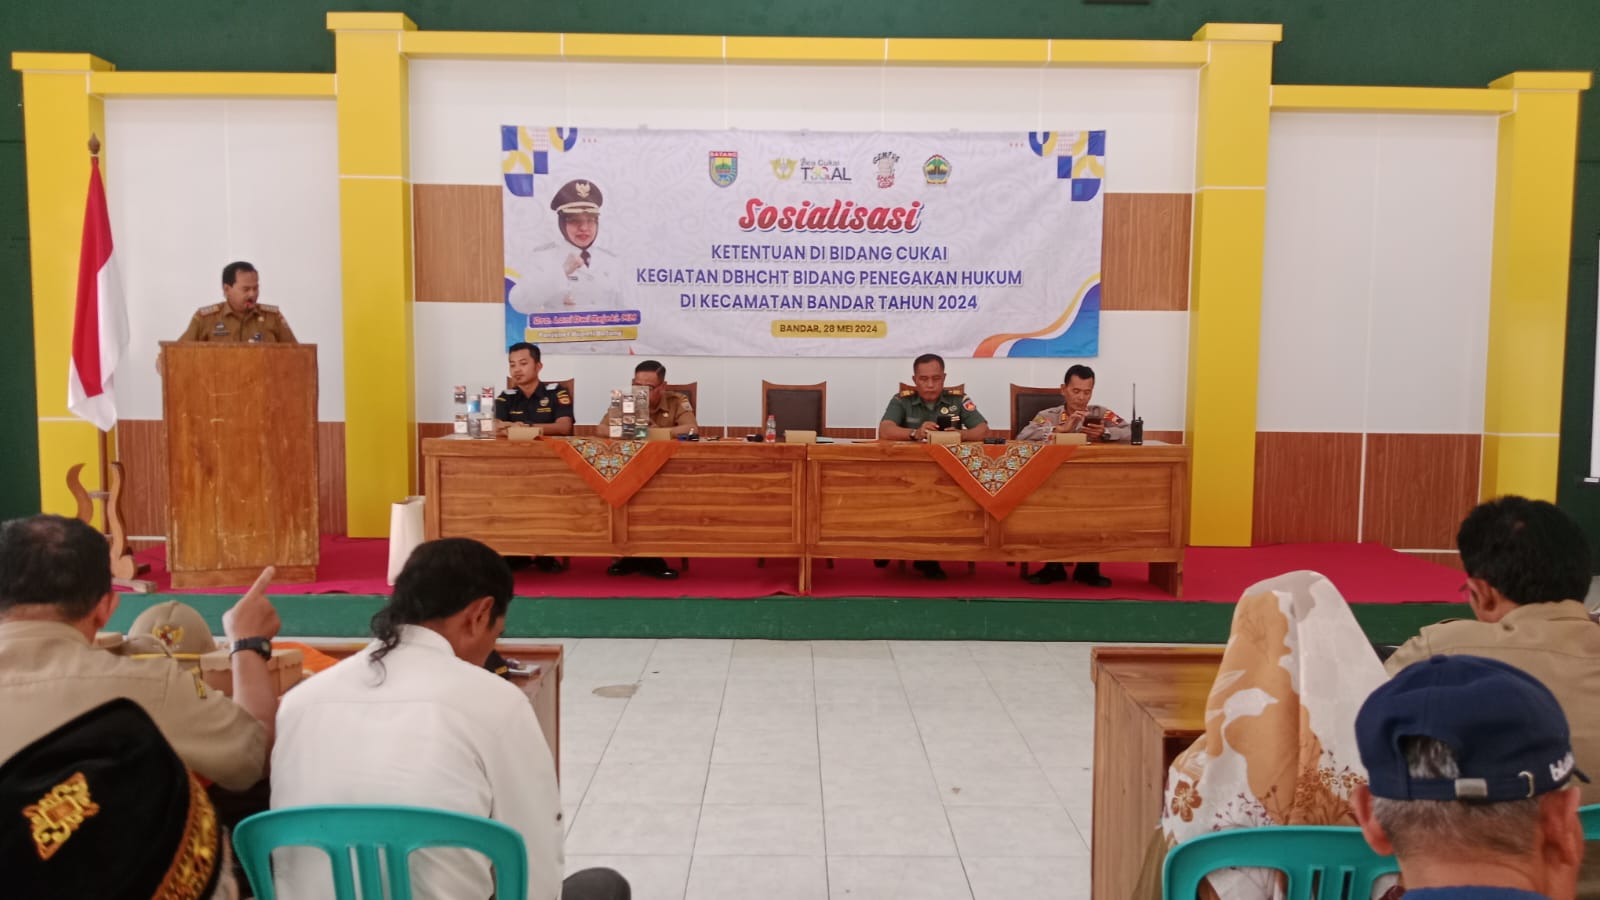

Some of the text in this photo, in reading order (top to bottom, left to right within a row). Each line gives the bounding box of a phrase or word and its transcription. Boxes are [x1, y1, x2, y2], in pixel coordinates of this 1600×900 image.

[738, 197, 924, 233] Sosialisasi
[711, 244, 948, 261] KETENTUAN DI BIDANG CUKAI
[636, 268, 1022, 285] KEGIATAN DBHCHT BIDANG PENEGAKAN HUKUM
[680, 293, 978, 310] DI KECAMATAN BANDAR TAHUN 2024
[779, 324, 878, 334] BANDAR, 28 MEI 2024
